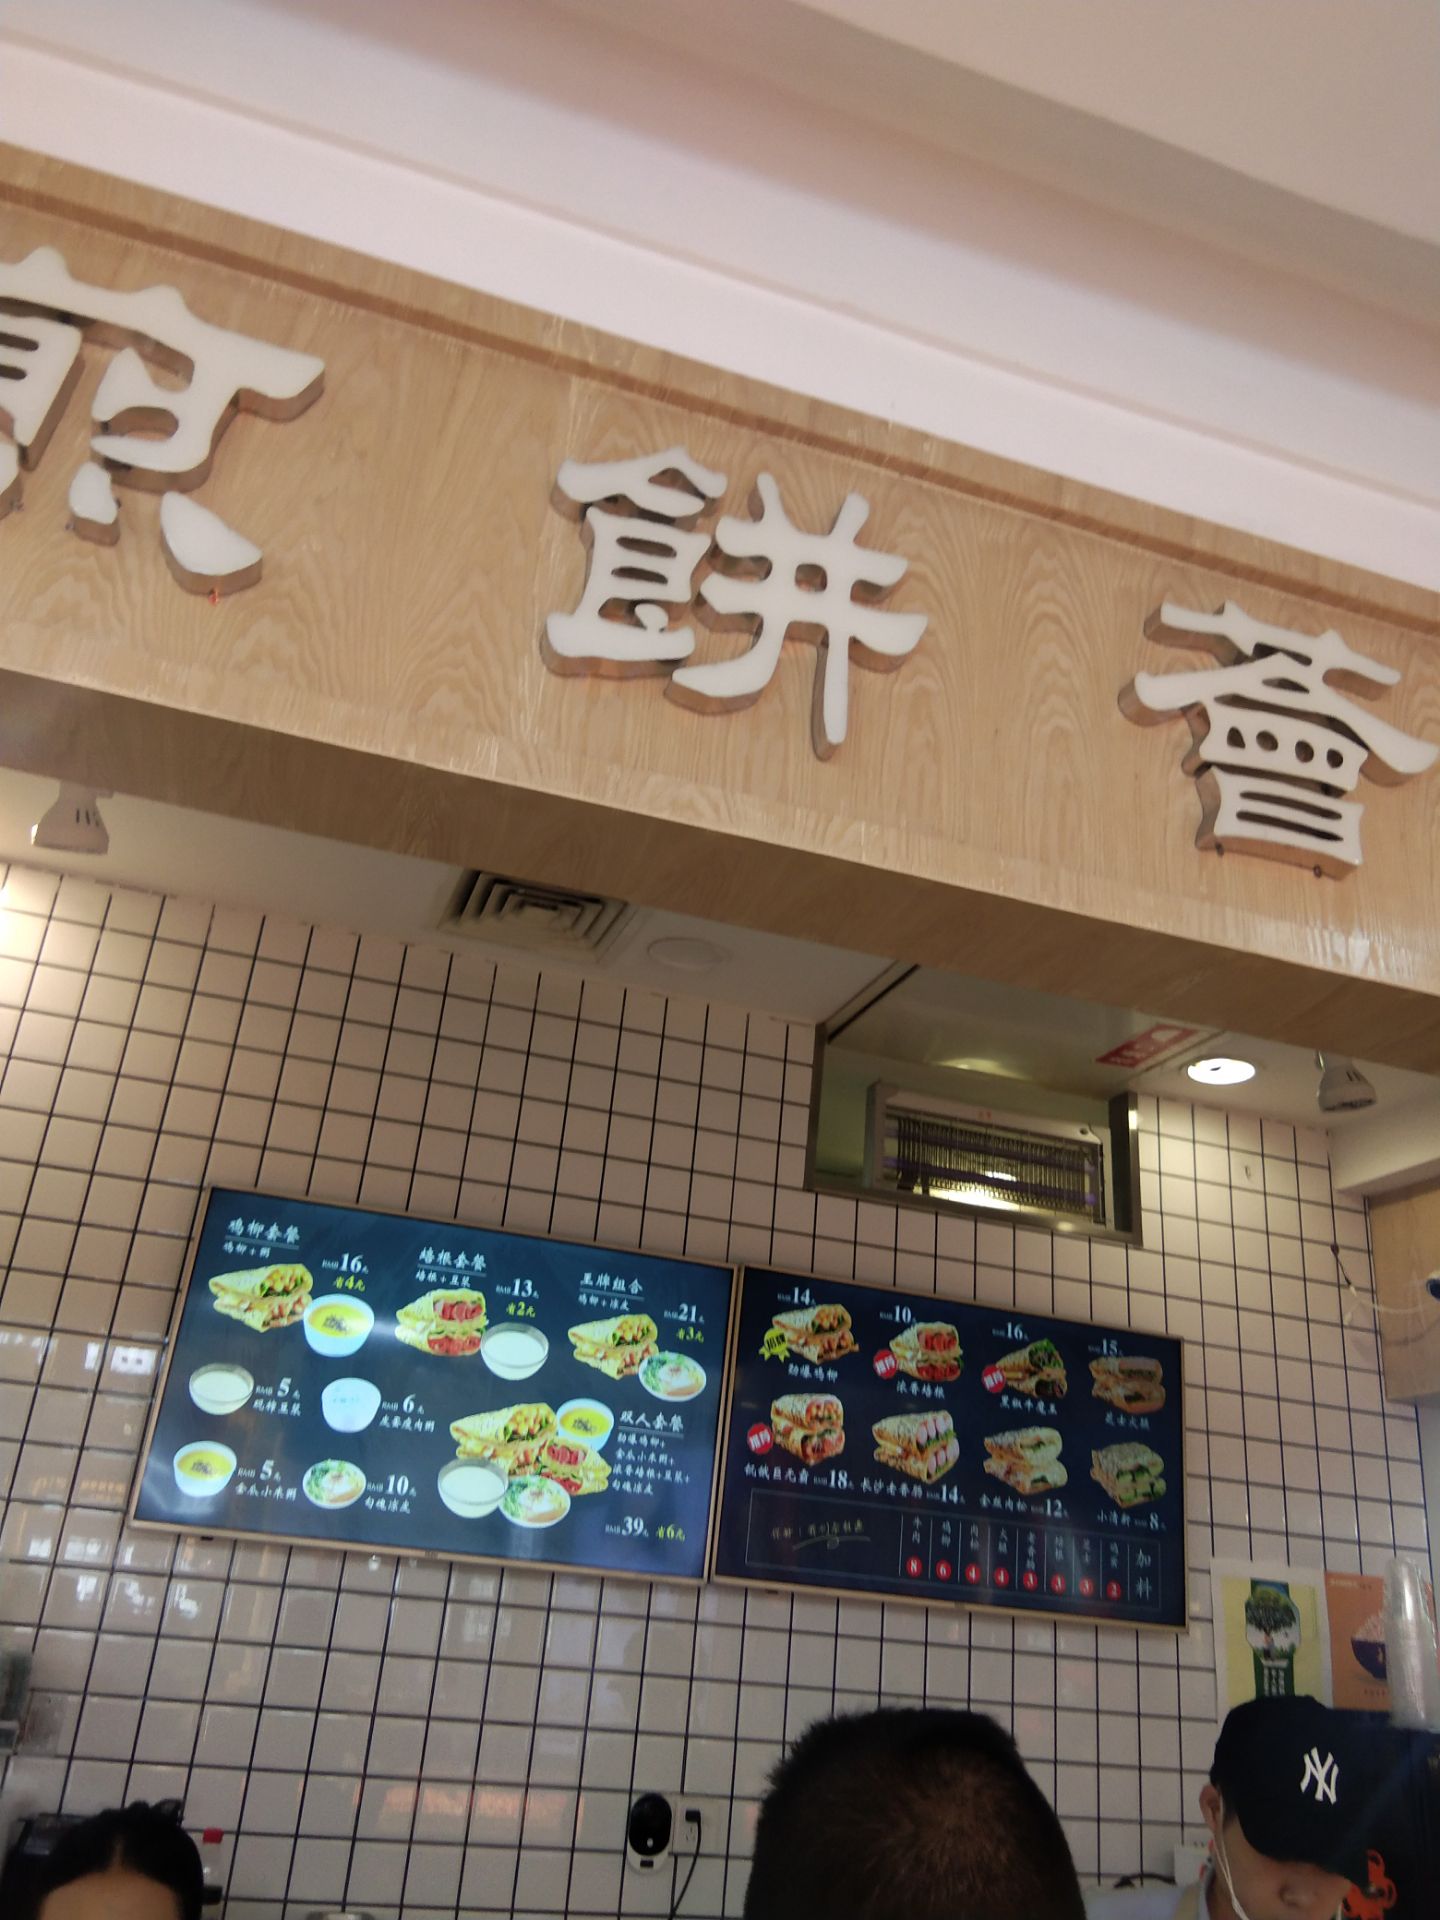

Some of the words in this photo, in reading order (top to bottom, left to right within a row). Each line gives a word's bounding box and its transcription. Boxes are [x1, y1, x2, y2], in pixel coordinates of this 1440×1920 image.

[418, 1246, 486, 1271] 培根套餐
[619, 1410, 684, 1433] 双人套餐
[1135, 1547, 1153, 1600] 加料
[1300, 1746, 1339, 1805] NY
